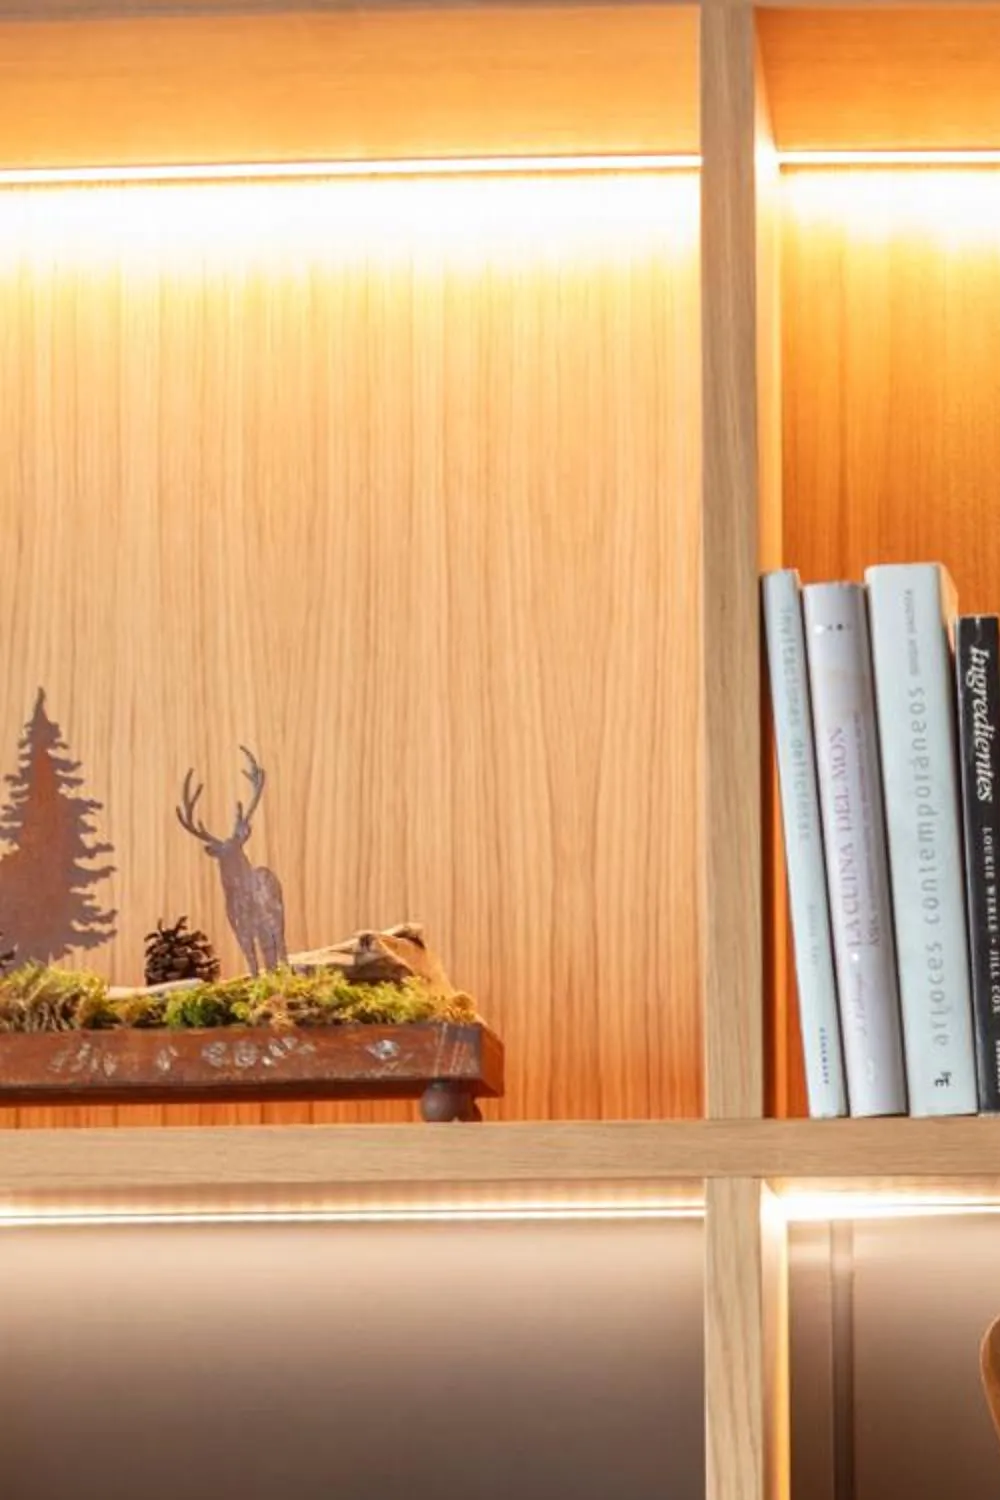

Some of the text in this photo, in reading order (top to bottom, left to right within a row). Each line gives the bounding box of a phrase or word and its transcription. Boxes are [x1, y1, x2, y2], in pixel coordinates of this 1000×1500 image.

[965, 645, 996, 803] Ingredientes
[834, 793, 853, 833] DEL
[908, 686, 940, 926] contemporáneos
[982, 827, 996, 880] LOUKIE
[985, 885, 999, 932] WERLE
[989, 950, 1000, 979] JILL
